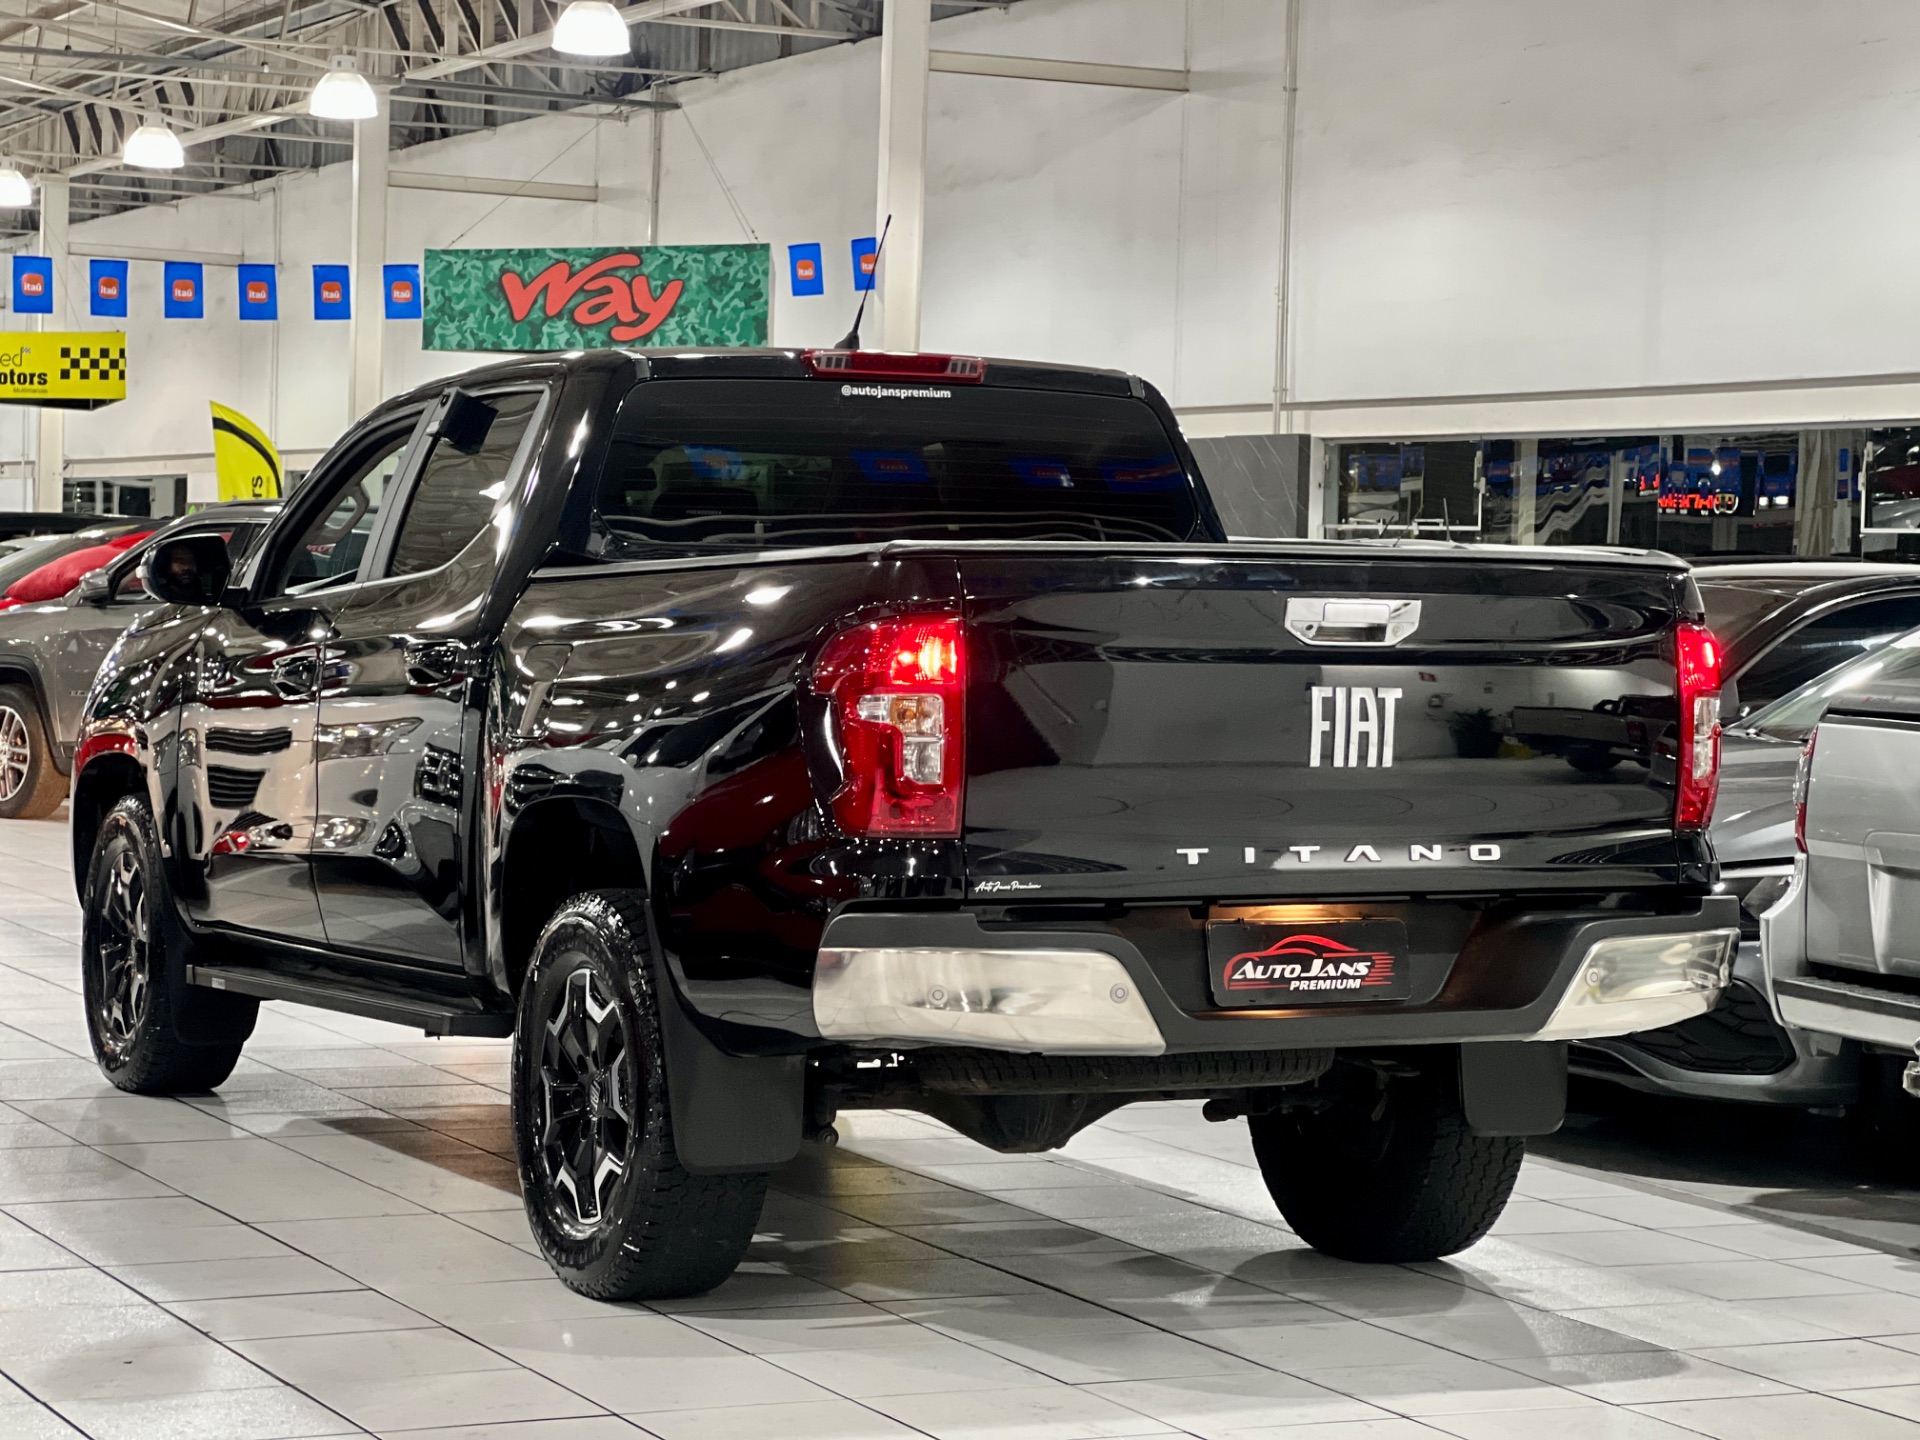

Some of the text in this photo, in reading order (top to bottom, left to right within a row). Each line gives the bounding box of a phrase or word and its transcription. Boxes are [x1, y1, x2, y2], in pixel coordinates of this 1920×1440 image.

[841, 385, 951, 399] @autojanspremium
[1309, 686, 1403, 768] FIAT
[1176, 844, 1501, 865] TITANO
[1290, 978, 1361, 991] PREMIUM
